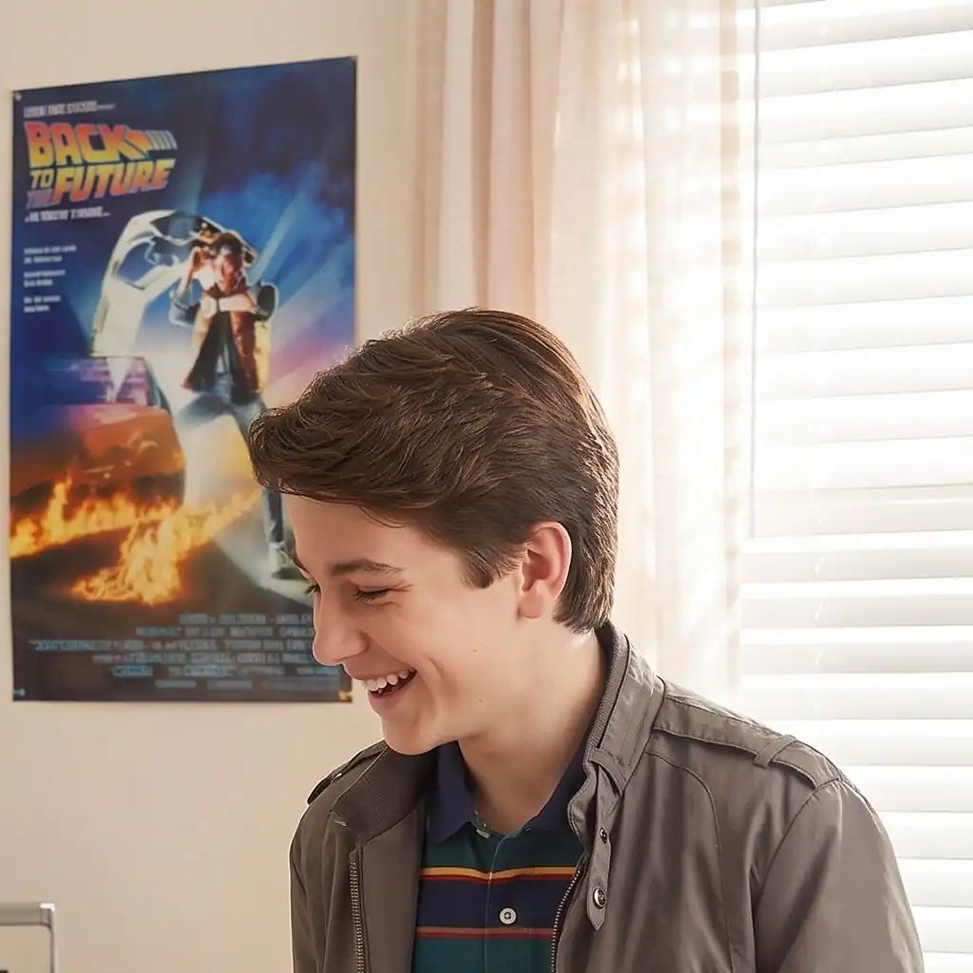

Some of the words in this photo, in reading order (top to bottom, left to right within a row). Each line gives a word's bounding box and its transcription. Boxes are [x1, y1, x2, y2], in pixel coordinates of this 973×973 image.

[24, 121, 150, 168] BACK
[30, 169, 54, 189] TO
[49, 158, 176, 206] FUTURE
